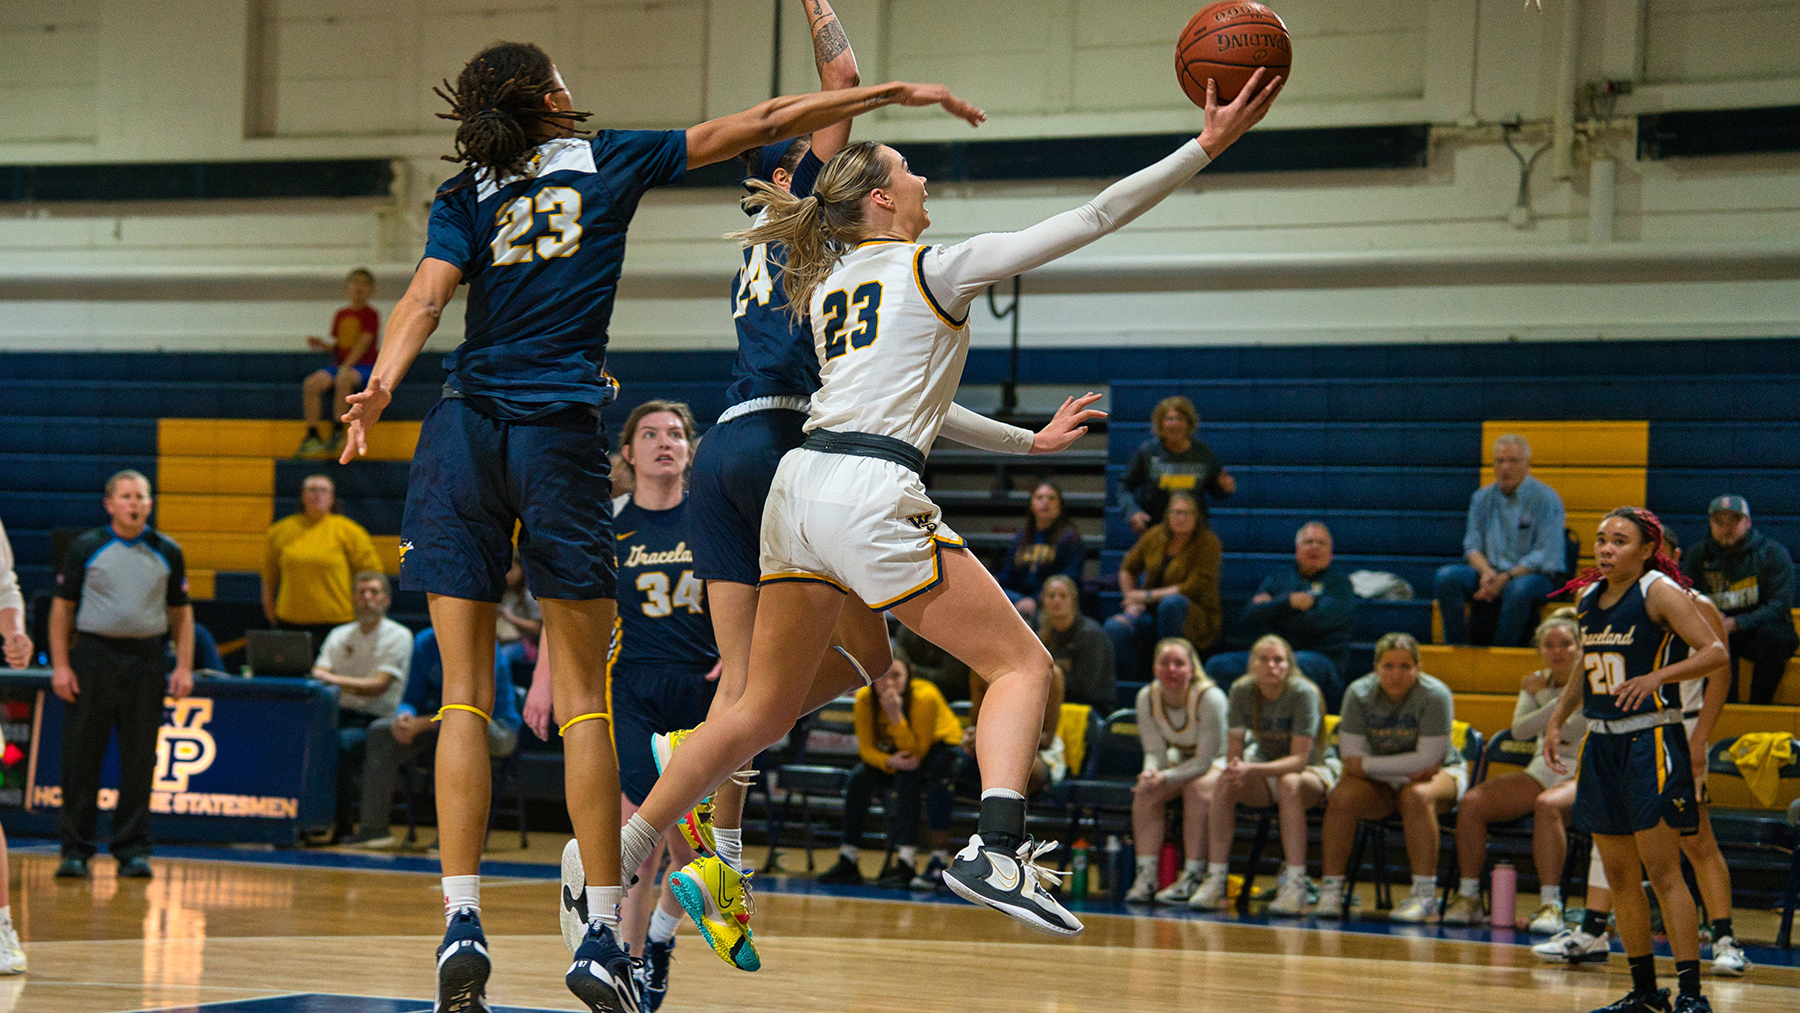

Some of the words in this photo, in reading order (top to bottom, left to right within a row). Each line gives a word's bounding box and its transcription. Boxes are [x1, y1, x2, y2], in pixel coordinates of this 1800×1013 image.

[1217, 33, 1290, 54] SPALDING
[490, 187, 583, 267] 23
[822, 279, 884, 362] 23
[623, 541, 693, 567] Gracela
[635, 571, 704, 617] 34
[1584, 651, 1626, 696] 20
[173, 792, 299, 820] STATESMEN
